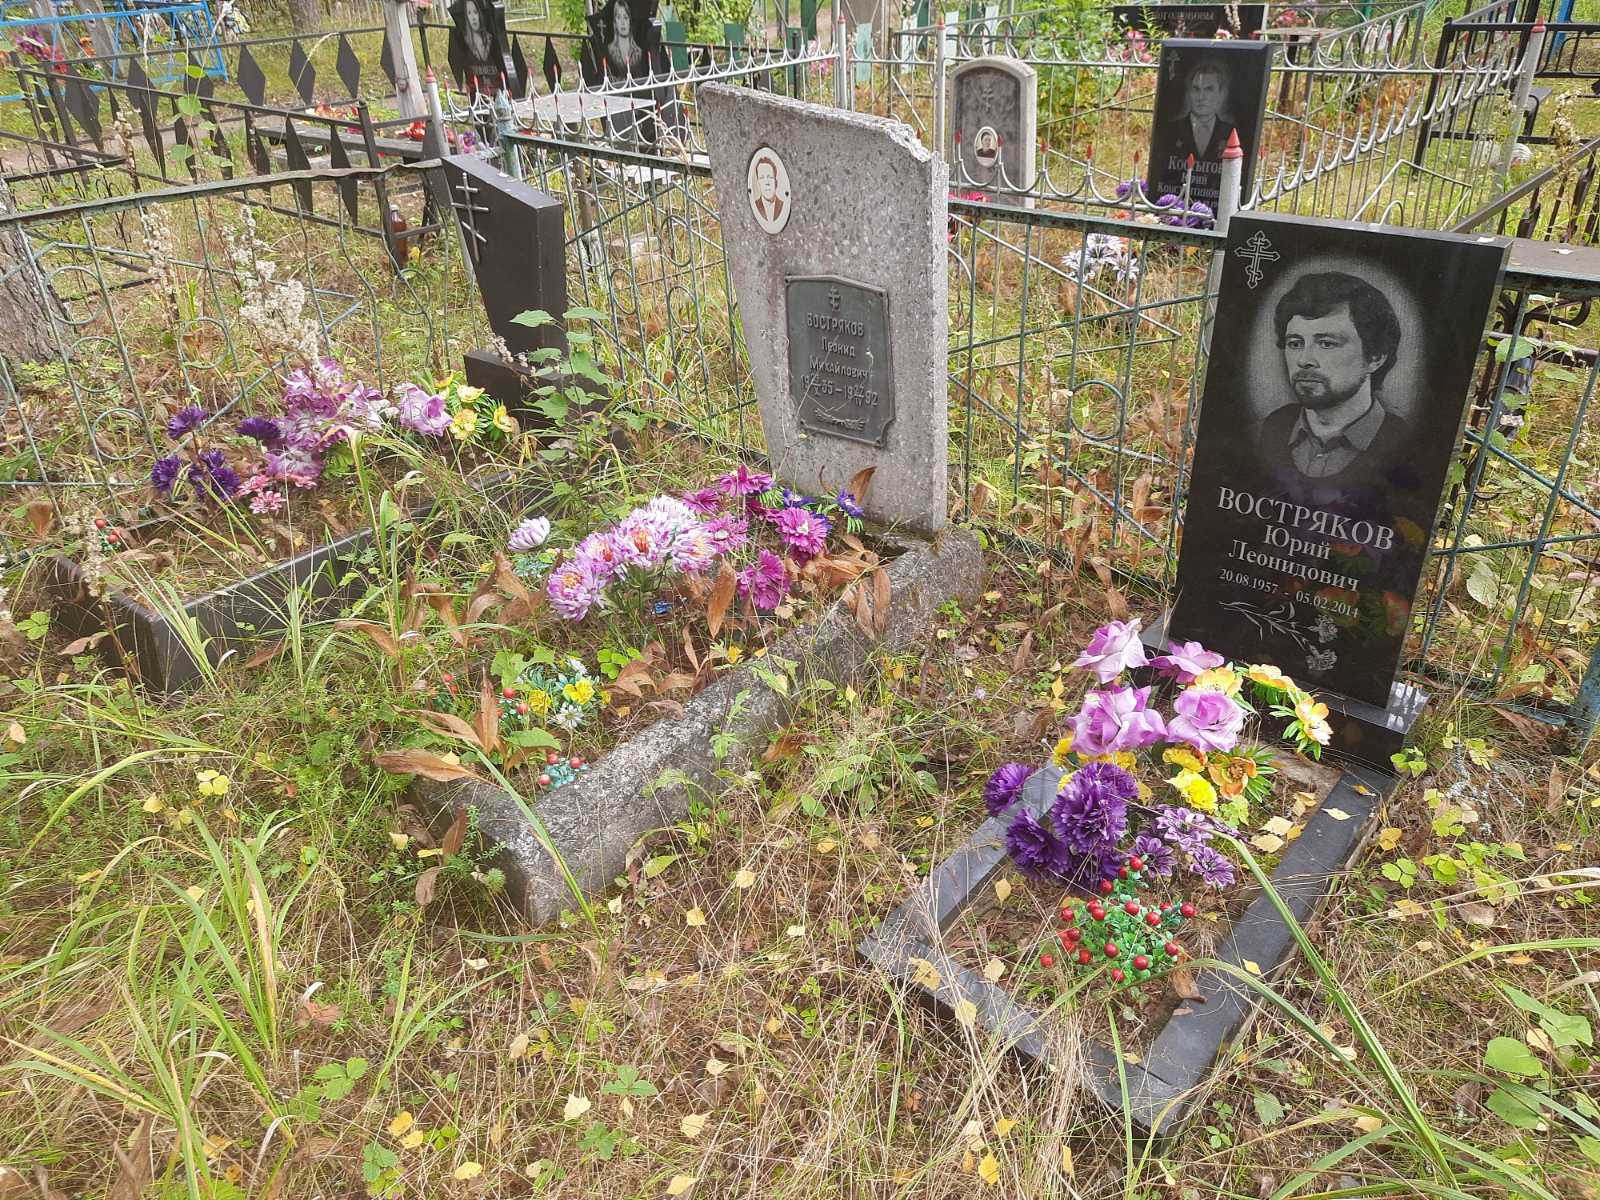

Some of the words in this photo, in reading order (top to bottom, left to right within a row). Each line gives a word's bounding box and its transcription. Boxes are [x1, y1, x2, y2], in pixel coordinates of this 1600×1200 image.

[806, 312, 865, 337] ВОСТРЯКОВ
[809, 355, 868, 379] Михайлович
[1217, 486, 1395, 551] ВОСТРЯКОВ
[1263, 524, 1332, 561] Юрий
[1228, 538, 1360, 593] Леонидович
[1219, 568, 1279, 595] 20.08.1957
[1295, 590, 1359, 619] 05.02.2014
